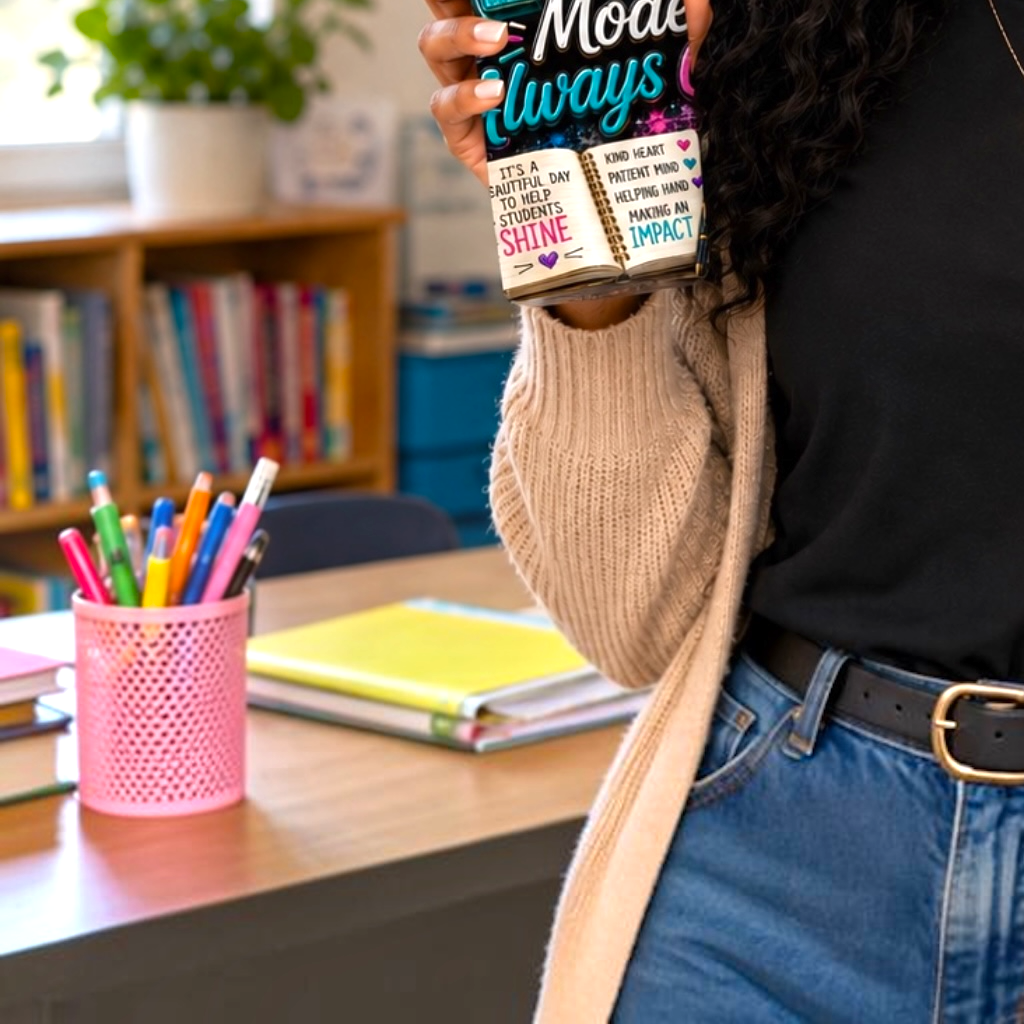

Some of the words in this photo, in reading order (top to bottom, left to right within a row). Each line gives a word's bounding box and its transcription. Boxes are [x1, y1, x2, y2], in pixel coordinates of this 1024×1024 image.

[604, 150, 629, 164] KIND
[633, 143, 665, 159] HEART
[499, 163, 525, 180] IT'S
[530, 160, 539, 173] A
[548, 170, 571, 185] DAY
[608, 165, 650, 184] PATIENT
[653, 161, 680, 176] MIND
[499, 196, 517, 211] TO
[521, 188, 551, 205] HELP
[614, 185, 660, 204] HELPING
[661, 179, 690, 195] HAND
[500, 202, 564, 227] STUDENTS
[628, 204, 672, 223] MAKING
[674, 201, 690, 214] AN
[500, 214, 573, 256] SHINE
[629, 215, 694, 248] IMPACT
